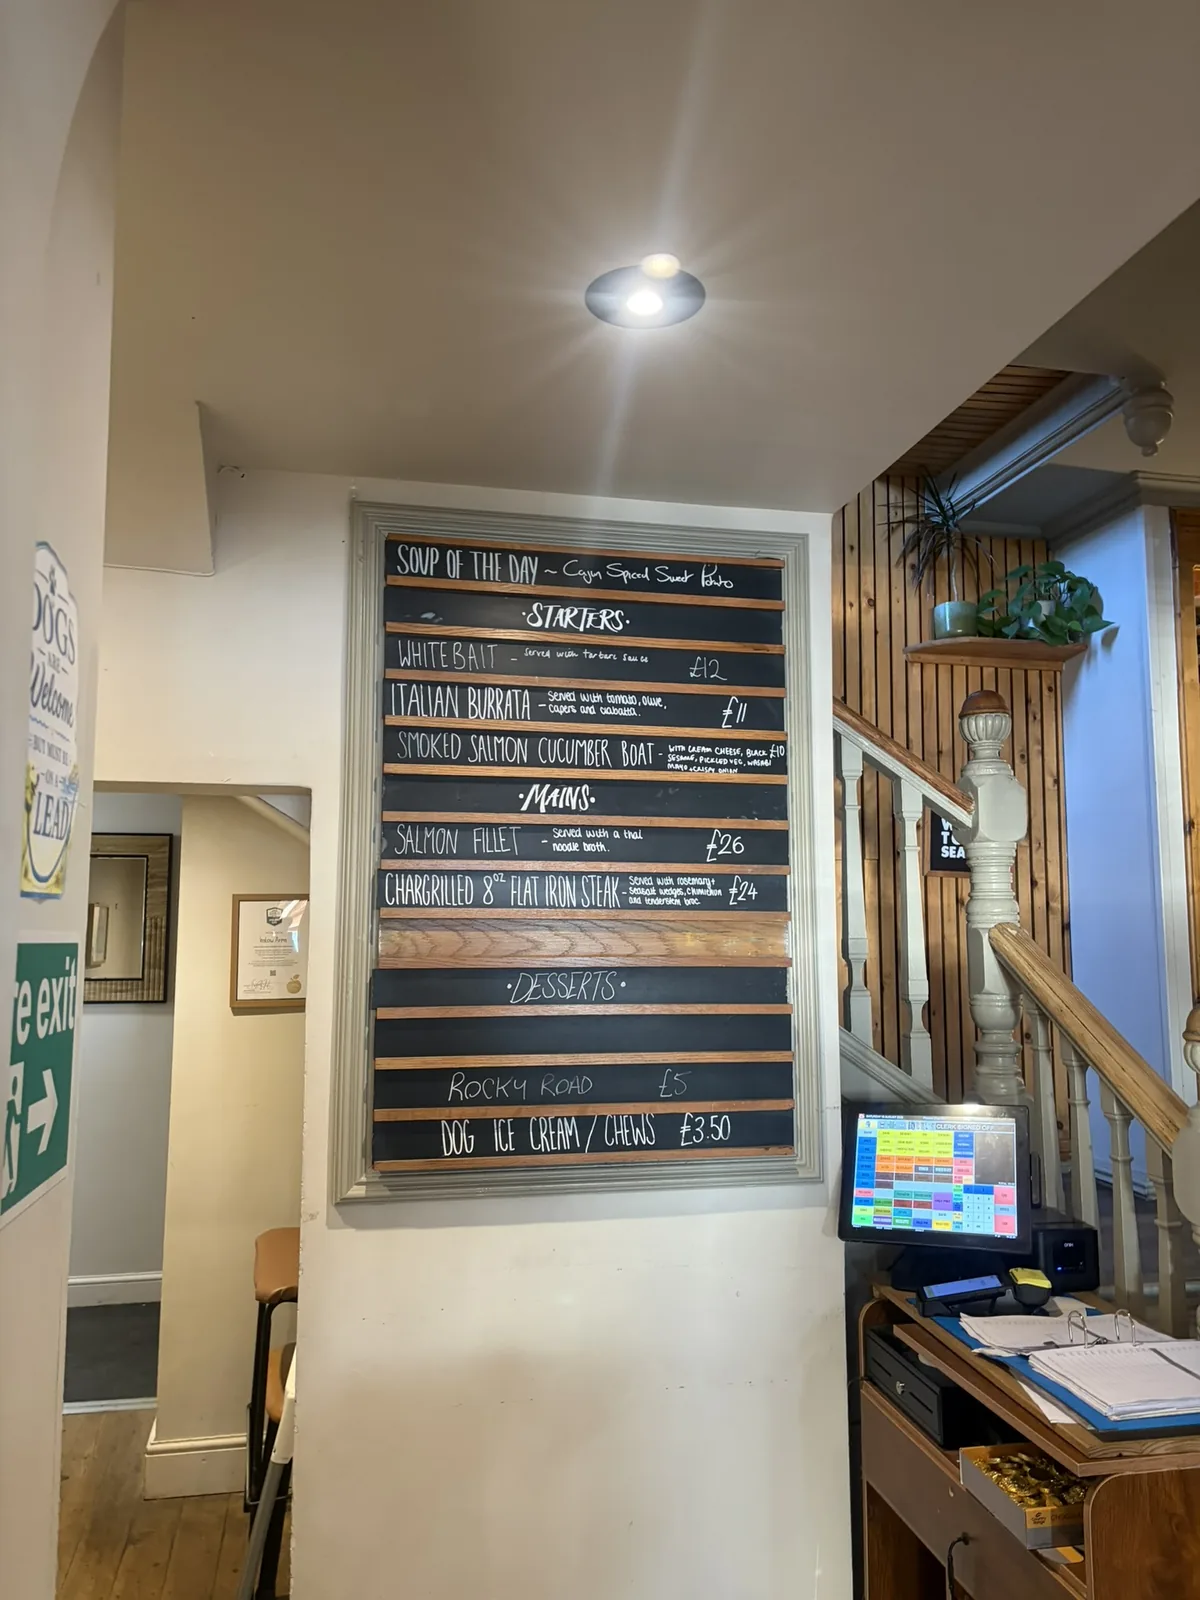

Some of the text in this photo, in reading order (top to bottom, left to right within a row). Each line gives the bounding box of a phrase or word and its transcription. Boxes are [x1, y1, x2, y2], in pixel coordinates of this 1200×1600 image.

[396, 544, 440, 576] SOUP
[446, 549, 464, 580] OF
[469, 551, 502, 582] THE
[508, 554, 538, 585] DAY
[606, 562, 650, 584] Spiced
[655, 565, 694, 584] Sweet
[556, 648, 579, 658] with
[689, 656, 727, 681] £12
[391, 683, 459, 718] ITALIAN
[467, 686, 531, 720] BURRATA
[721, 696, 747, 728] £11
[548, 703, 577, 716] capers
[580, 705, 596, 715] and
[580, 692, 603, 703] with
[397, 730, 462, 760] SMOKED
[467, 734, 528, 764] SALMON
[538, 737, 613, 768] CUCUMBER
[621, 740, 655, 767] BOAT
[668, 744, 686, 753] WITH
[688, 745, 713, 754] CREAM
[746, 749, 768, 758] BLACK
[769, 744, 785, 759] £10
[699, 756, 728, 765] PICKLED
[33, 790, 70, 841] LEAD
[394, 823, 459, 855] SALMON
[473, 826, 522, 856] FILLET
[706, 829, 745, 862] £26
[552, 841, 580, 853] noodle
[586, 828, 609, 839] with
[613, 831, 620, 839] a
[623, 829, 643, 840] thai
[385, 872, 474, 906] CHARGRILLED
[510, 875, 540, 907] FLAT
[545, 874, 577, 908] IRON
[581, 874, 621, 909] STEAK
[729, 875, 758, 906] £24
[656, 876, 675, 886] with
[628, 896, 642, 905] and
[37, 956, 76, 1039] exit
[540, 1073, 593, 1097] ROAD
[658, 1068, 692, 1098] £5
[441, 1119, 475, 1157] DOG
[493, 1118, 516, 1152] ICE
[529, 1115, 581, 1153] CREAM
[604, 1114, 656, 1146] CHEWS
[680, 1112, 731, 1147] £3.50
